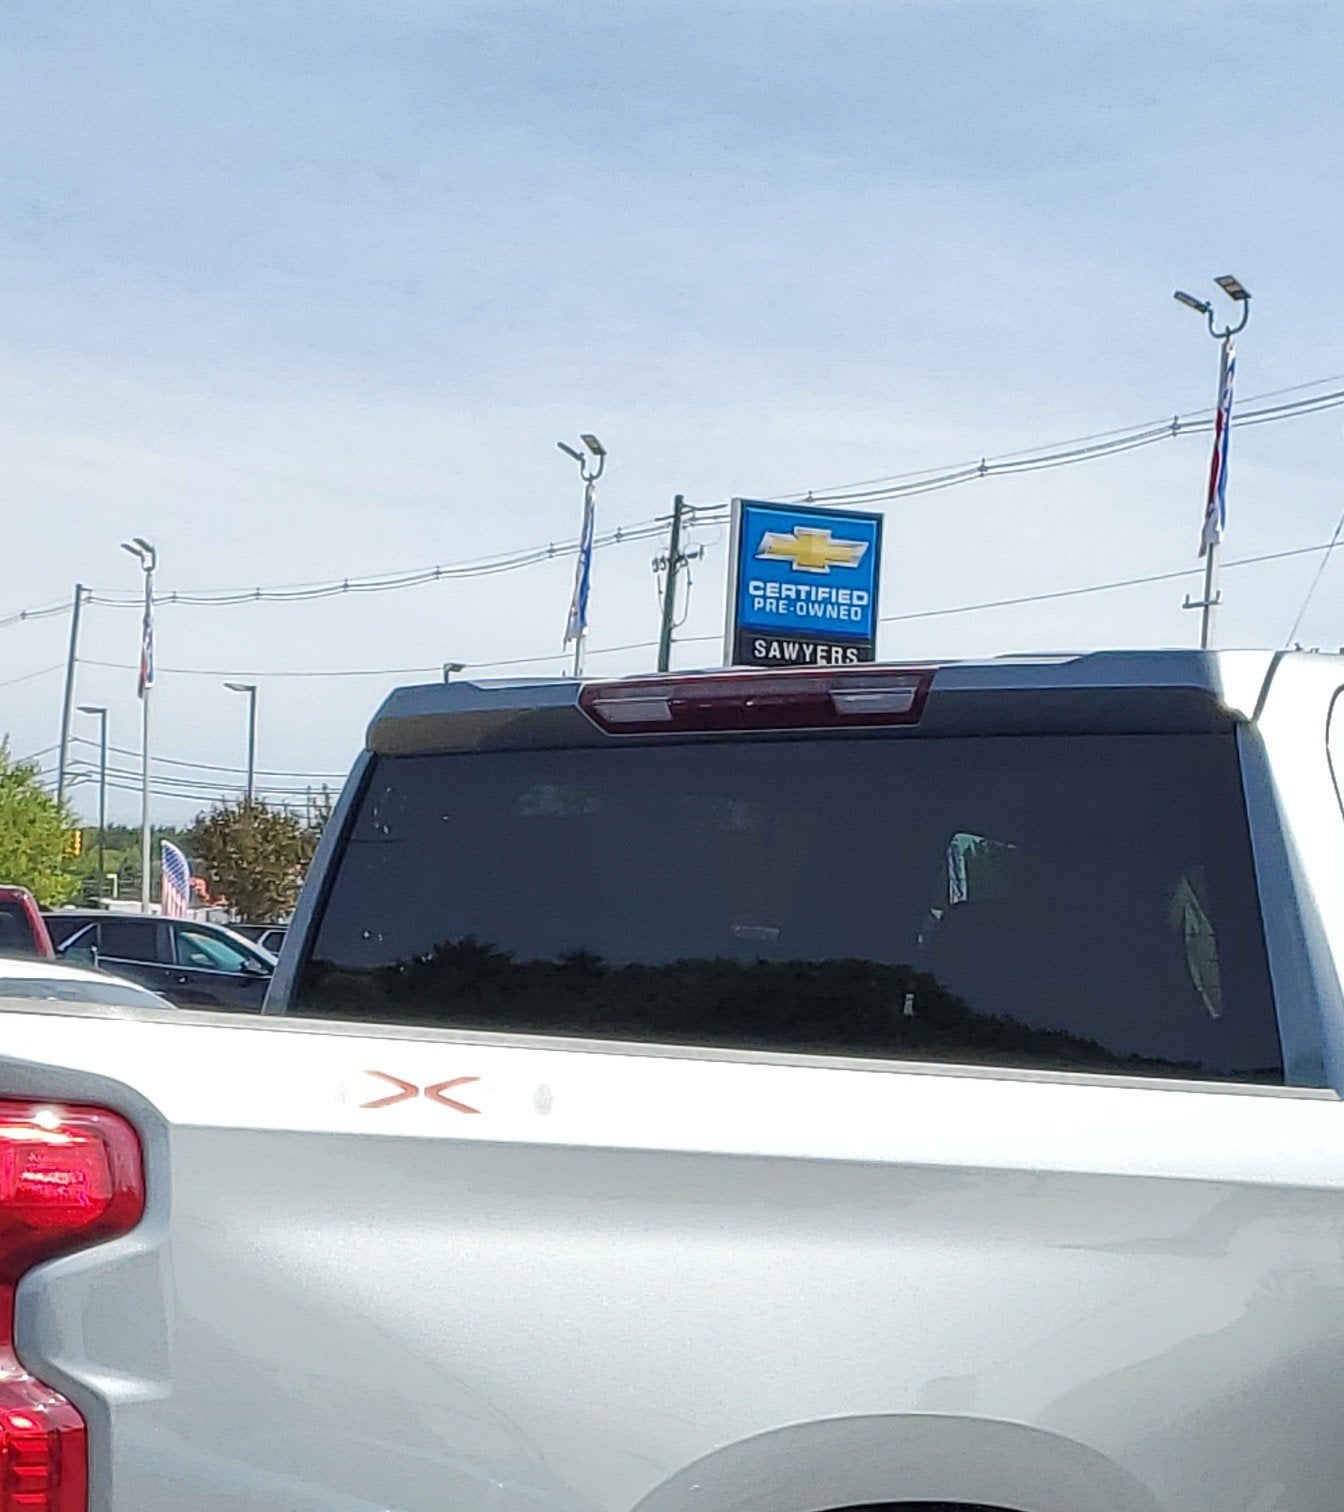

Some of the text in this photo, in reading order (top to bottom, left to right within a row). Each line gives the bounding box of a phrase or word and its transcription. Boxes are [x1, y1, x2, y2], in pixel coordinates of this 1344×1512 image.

[748, 580, 869, 606] CERTIFIED
[753, 597, 862, 621] PRE-OWNED
[754, 639, 859, 665] SAWYERS
